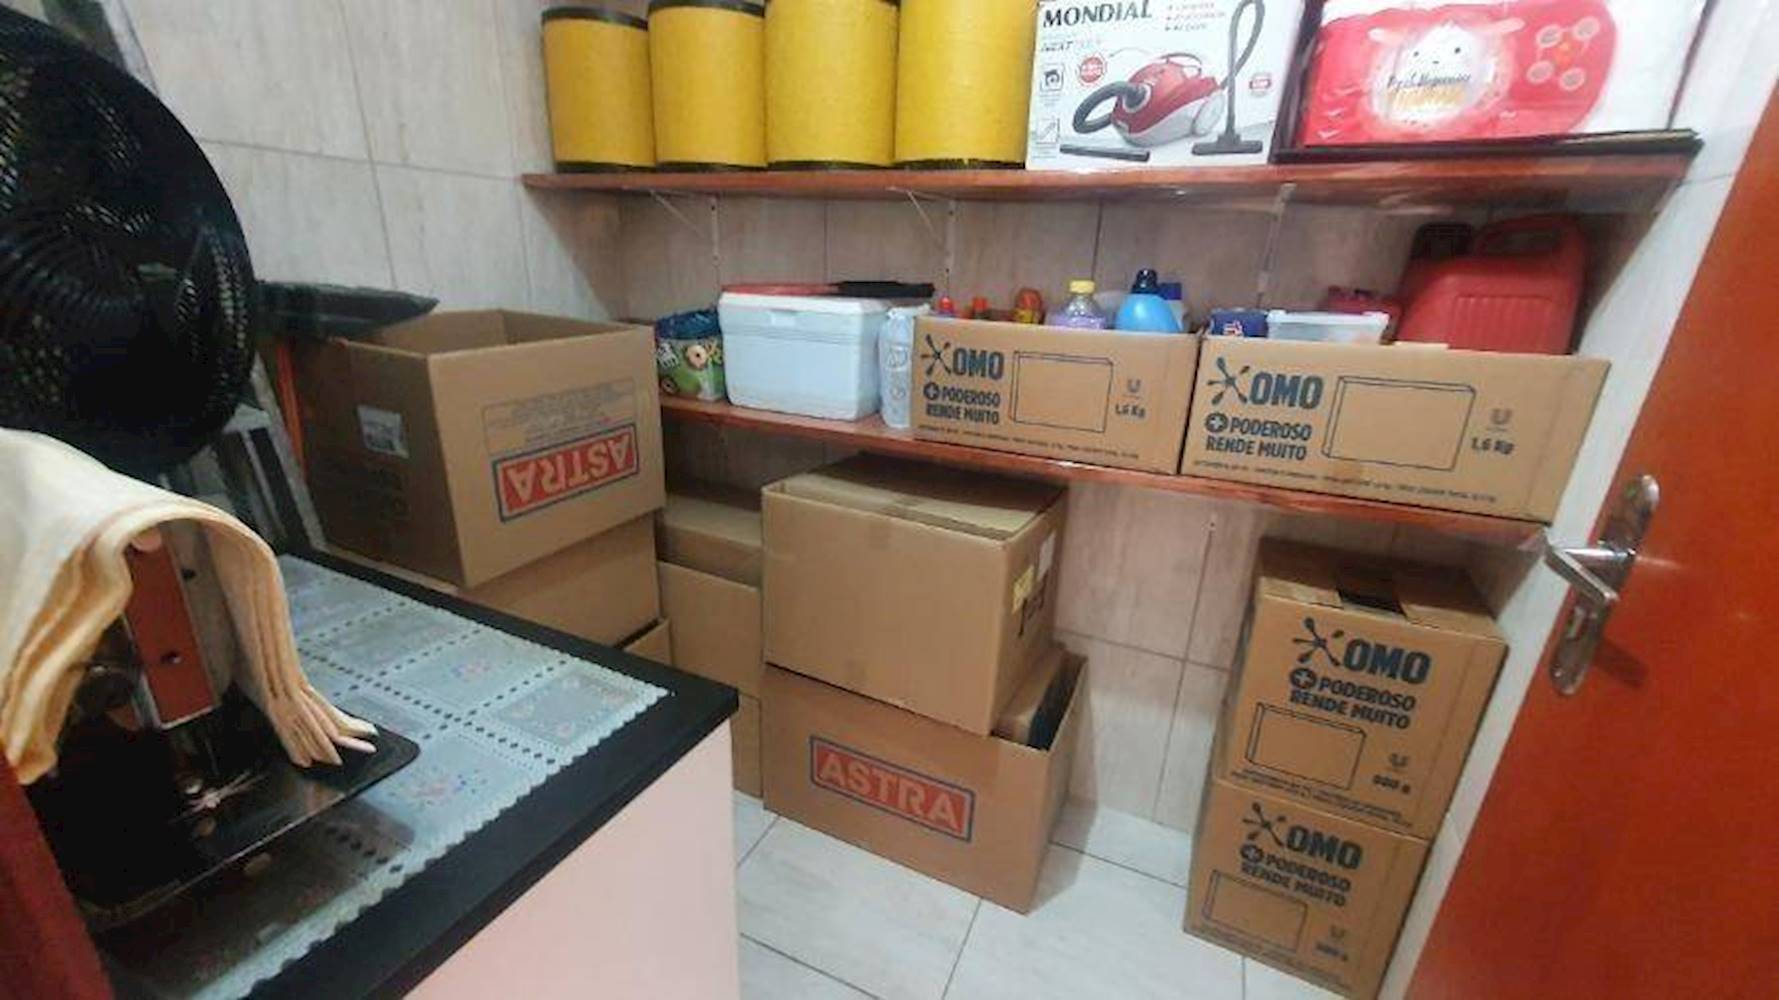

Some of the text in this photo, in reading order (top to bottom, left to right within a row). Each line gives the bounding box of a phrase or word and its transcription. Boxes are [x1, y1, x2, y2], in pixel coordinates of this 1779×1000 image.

[1043, 0, 1152, 27] MONDIAL
[953, 347, 1004, 380] OMO
[941, 386, 1000, 408] PODEROSO
[1250, 371, 1324, 409] OMO
[926, 403, 999, 424] RENDE MUITO
[1230, 416, 1312, 441] PODEROSO
[1206, 435, 1307, 461] RENDE MUITO
[506, 434, 630, 501] ASTRA
[1343, 638, 1431, 685] OMO
[1290, 690, 1410, 729] RENDE MUITO
[1318, 676, 1416, 711] PODEROSO
[818, 753, 960, 830] ASTRA
[1286, 825, 1363, 870] OMO
[1241, 862, 1347, 907] RENDE MUITO
[1265, 854, 1351, 893] PODEROSO
